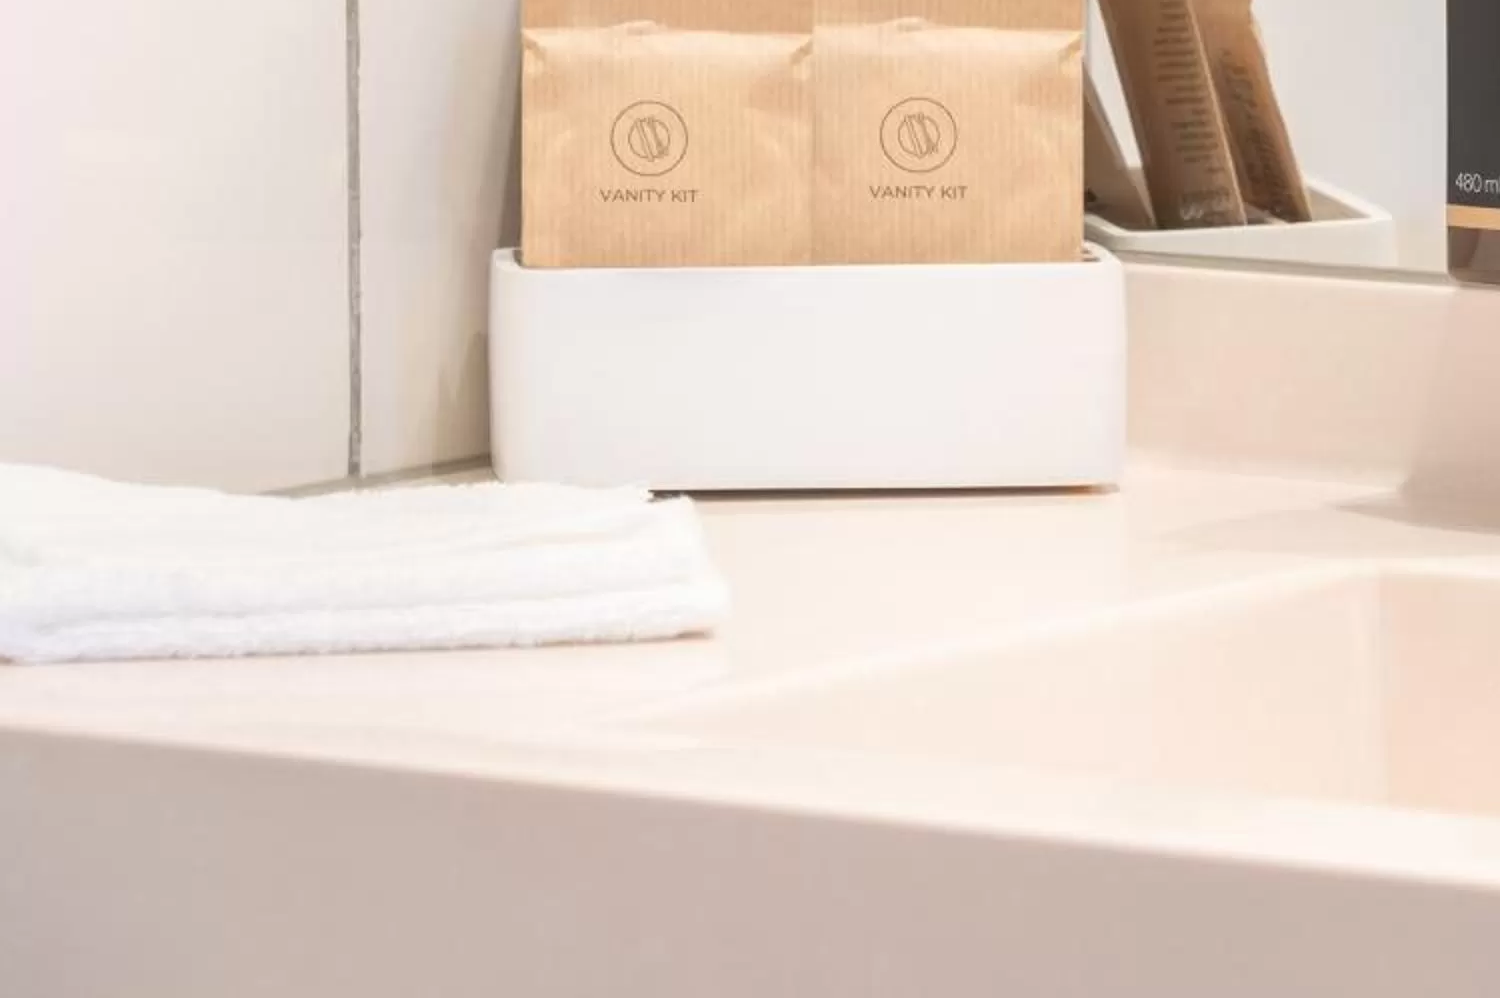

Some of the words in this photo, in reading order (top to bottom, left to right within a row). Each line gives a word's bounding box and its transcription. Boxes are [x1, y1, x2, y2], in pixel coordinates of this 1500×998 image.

[1455, 172, 1482, 193] 480
[600, 189, 666, 203] VANITY
[671, 189, 699, 203] KIT
[869, 185, 936, 199] VANITY
[941, 185, 968, 199] KIT
